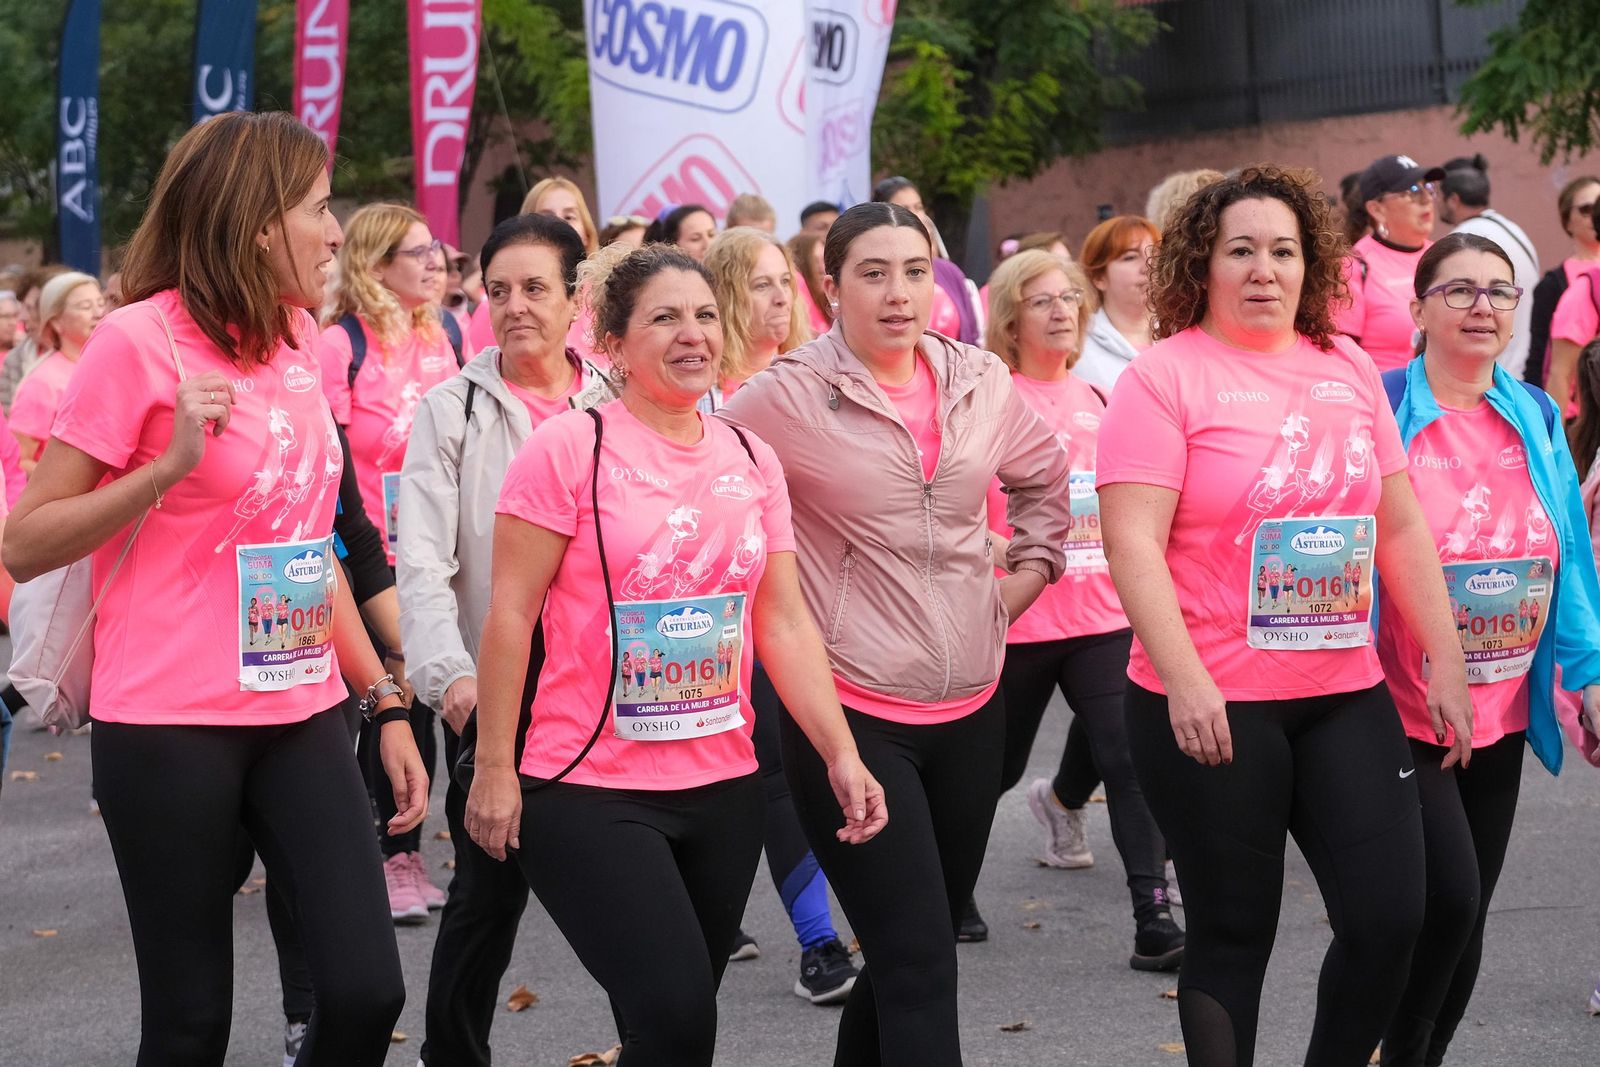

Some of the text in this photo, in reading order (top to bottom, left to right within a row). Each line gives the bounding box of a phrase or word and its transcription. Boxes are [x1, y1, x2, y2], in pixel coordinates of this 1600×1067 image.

[59, 96, 87, 223] ABC
[1217, 390, 1270, 404] OYSHO
[1414, 455, 1462, 470] OYSHO
[1260, 533, 1282, 541] SUMA
[1295, 537, 1342, 549] ASTURIANA
[248, 561, 273, 570] SUMA
[1296, 575, 1343, 598] 016
[1469, 578, 1515, 590] ASTURIANA
[1309, 603, 1332, 613] 1072
[291, 605, 325, 632] 016
[620, 616, 646, 625] SUMA
[1269, 616, 1299, 624] CARRERA
[1300, 616, 1309, 624] DE
[1311, 615, 1319, 623] LA
[1320, 614, 1339, 623] MUJER
[1471, 613, 1516, 636] 016
[661, 620, 711, 633] ASTURIANA
[298, 635, 316, 646] 1869
[1264, 631, 1309, 642] OYSHO
[1482, 639, 1503, 650] 1073
[263, 653, 293, 662] CARRERA
[665, 658, 715, 684] 016
[679, 688, 703, 700] 1075
[637, 704, 669, 713] CARRERA
[681, 703, 690, 711] LA
[691, 700, 710, 709] MUJER
[713, 695, 730, 706] SEVILLA
[632, 719, 680, 733] OYSHO
[705, 713, 732, 727] Santander
